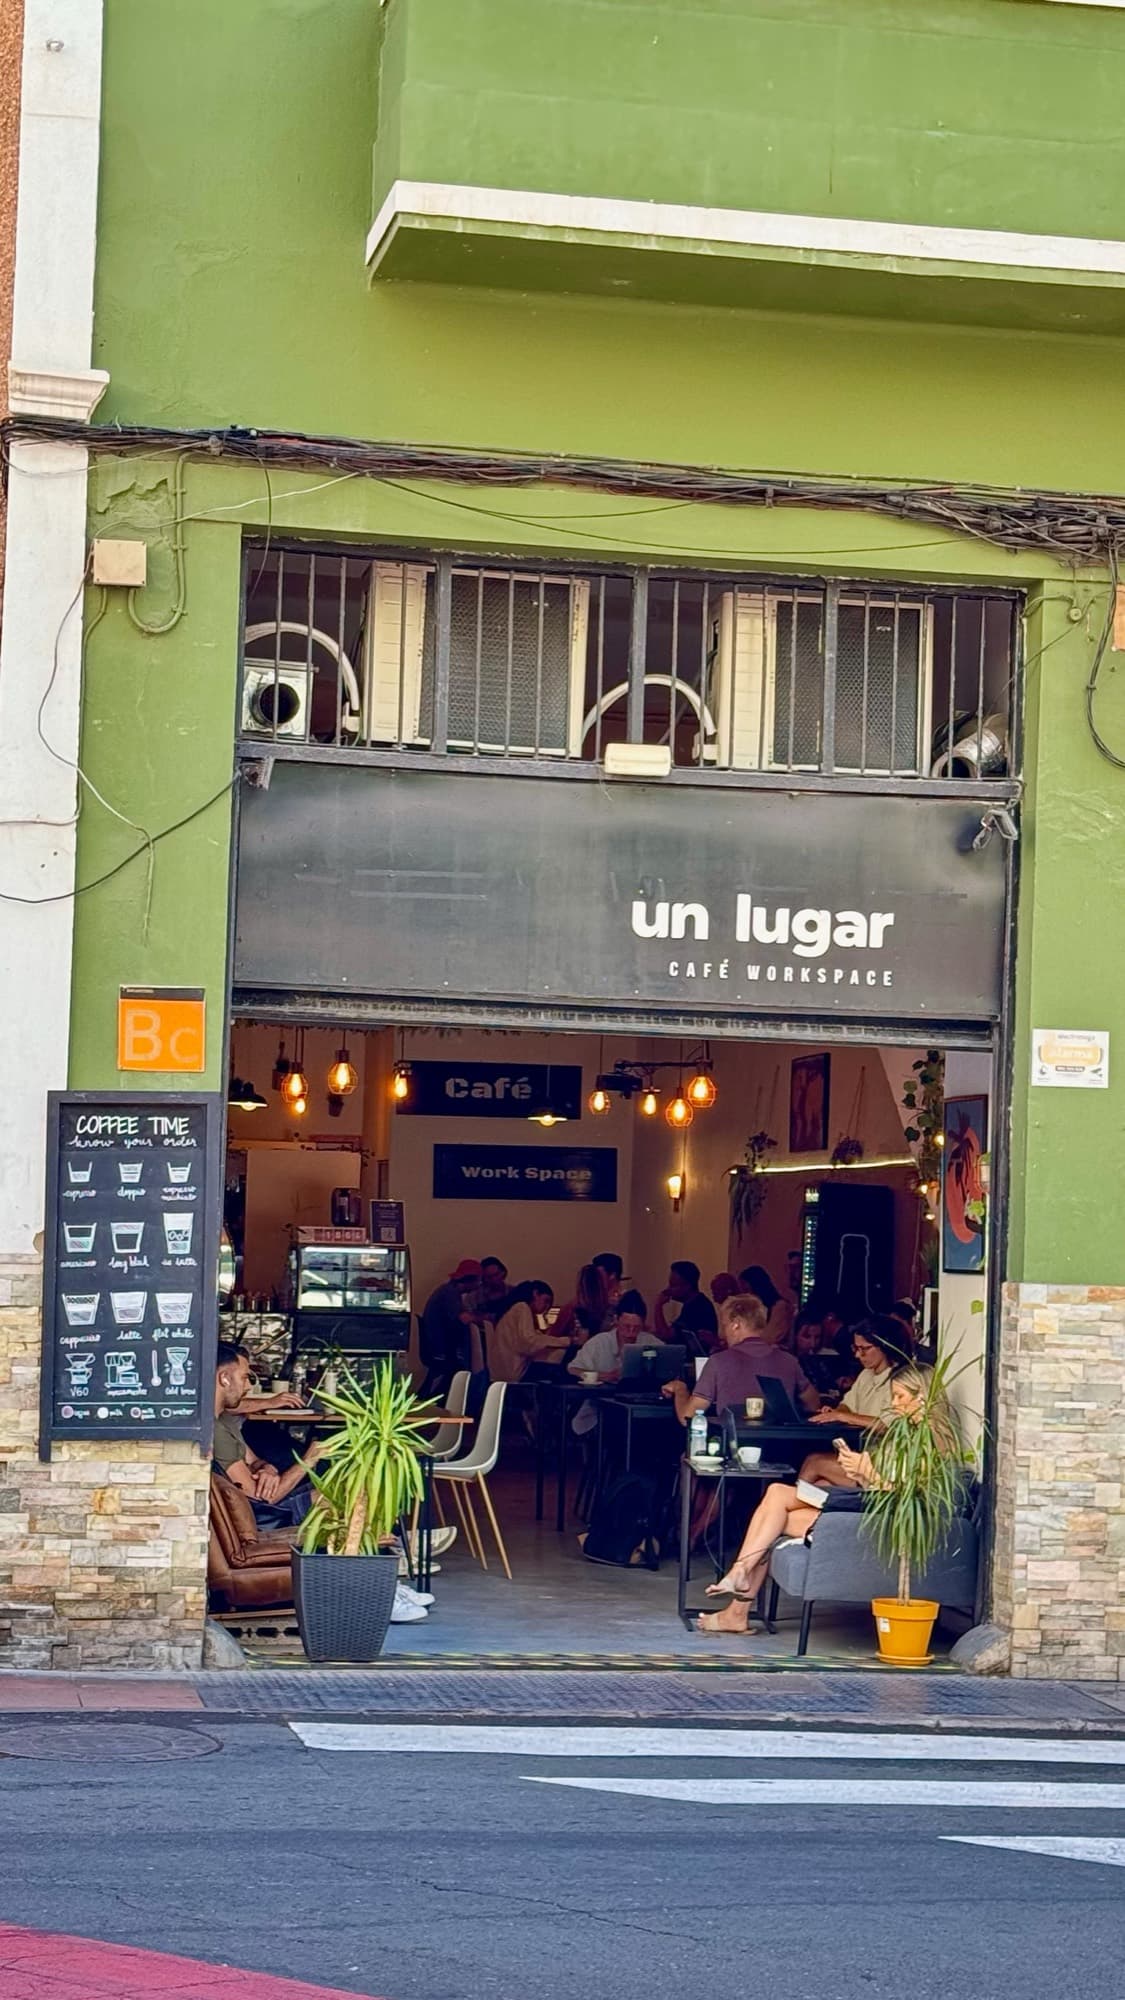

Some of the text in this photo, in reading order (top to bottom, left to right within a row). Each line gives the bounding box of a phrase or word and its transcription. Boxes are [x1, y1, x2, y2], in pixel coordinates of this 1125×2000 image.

[631, 893, 895, 958] un lugar
[668, 958, 893, 987] CAFÉ WORKSPACE
[445, 1076, 533, 1100] Café
[76, 1115, 190, 1136] COFFEE TIME
[68, 1136, 198, 1149] know your order
[461, 1166, 593, 1183] Work Space
[70, 1387, 89, 1396] V60
